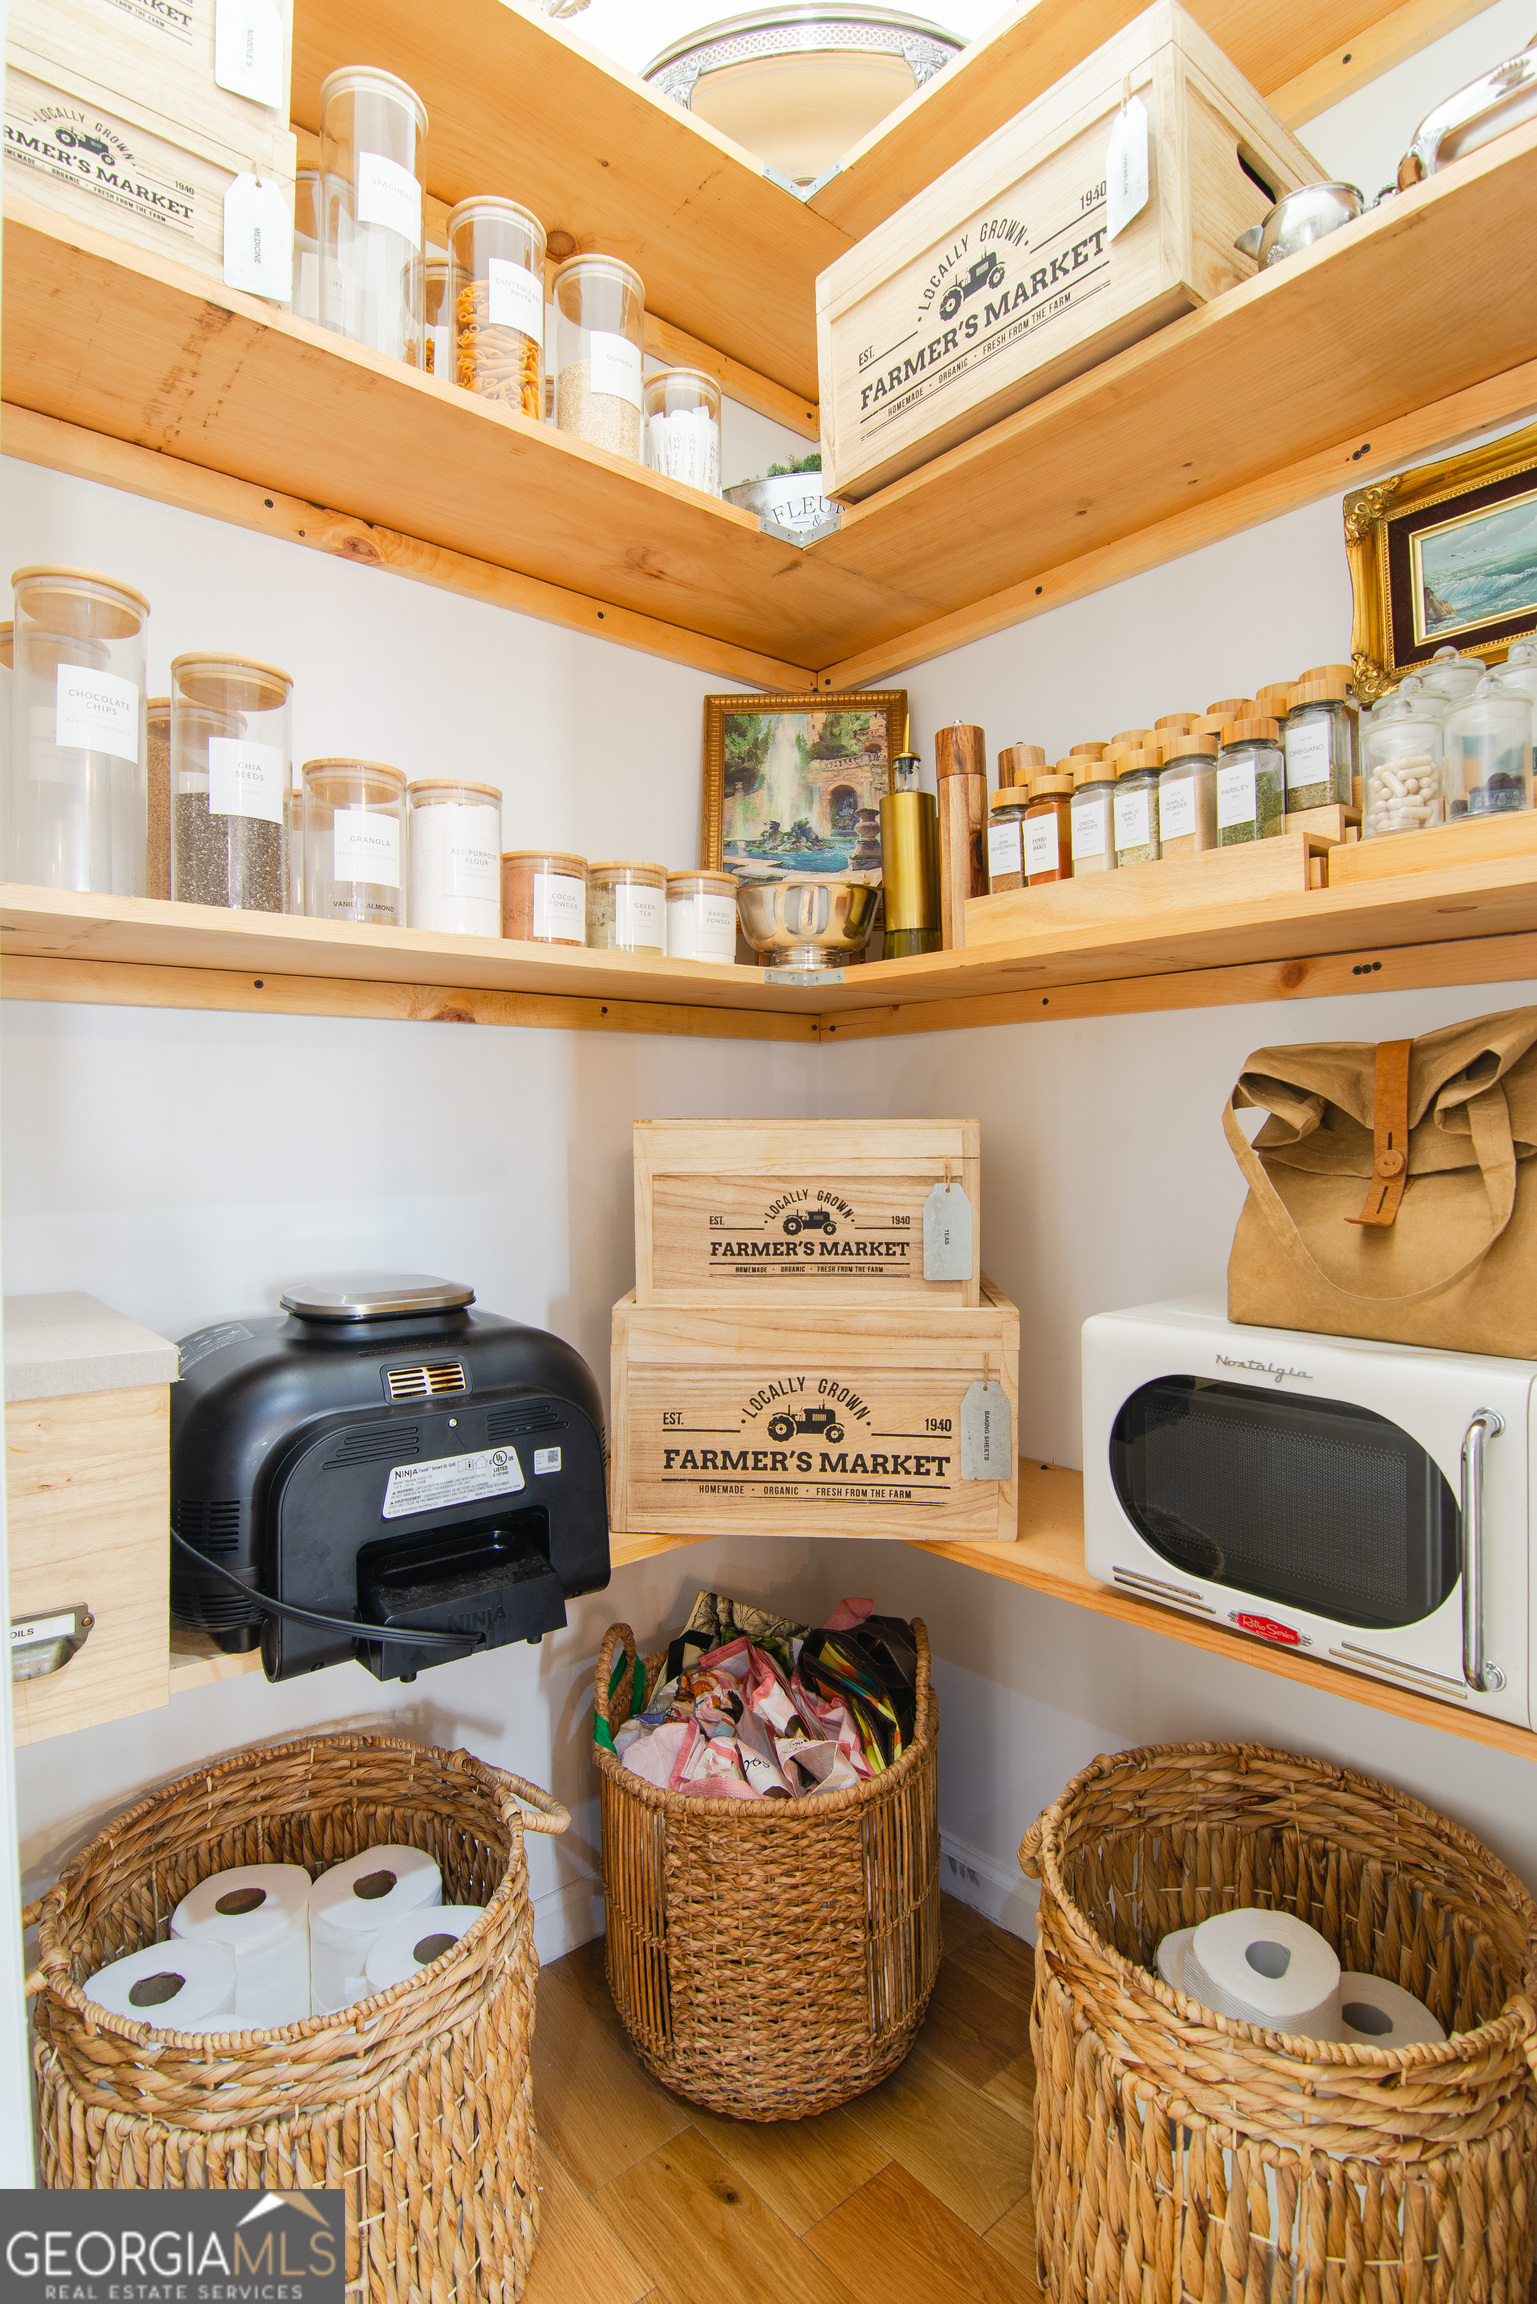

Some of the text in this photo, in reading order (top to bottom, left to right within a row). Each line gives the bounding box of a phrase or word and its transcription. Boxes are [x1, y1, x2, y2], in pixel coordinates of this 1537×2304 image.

[34, 107, 135, 160] LOCALLY GROWN
[96, 166, 194, 219] MARKET
[175, 180, 194, 195] 1940
[1080, 180, 1107, 210] 1940
[254, 226, 262, 265] MEDICINE
[918, 218, 1028, 311] LOCALLY GROWN
[860, 225, 1108, 411] FARMER'S MARKET
[859, 345, 875, 367] EST.
[887, 291, 1071, 417] HOMEMADE ORGANIC FRESH FROM THE FARM
[606, 354, 633, 369] QUINOA
[68, 689, 131, 712] CHOCOLATE
[85, 701, 117, 716] CHIPS
[1288, 743, 1325, 758] OREGANO
[238, 761, 262, 772] CHIA
[235, 770, 264, 782] SEEDS
[1221, 783, 1250, 796] PARSLEY
[1165, 802, 1188, 812] POWDER
[1166, 797, 1186, 807] GARLIC
[350, 835, 391, 847] GRANOLA
[451, 848, 498, 862] ALL-PURPOSE
[465, 857, 489, 866] FLOUR
[551, 893, 576, 902] COCOA
[366, 902, 395, 913] ALMOND
[549, 900, 578, 910] POWDER
[634, 903, 656, 911] GREEN
[706, 917, 731, 926] POWDER
[707, 911, 730, 919] BAKING
[767, 1188, 855, 1220] LOCALLY GROWN
[709, 1216, 725, 1226] EST.
[891, 1215, 911, 1225] 1940
[710, 1240, 910, 1257] FARMER'S MARKET
[735, 1266, 768, 1274] HOMEMADE
[1215, 1354, 1314, 1384] Nostalgia
[742, 1376, 871, 1421] LOCALLY GROWN
[663, 1412, 685, 1426] EST.
[924, 1418, 952, 1432] 1940
[495, 1453, 504, 1463] UL
[663, 1449, 951, 1477] FARMER'S MARKET
[394, 1468, 418, 1480] NINJA
[493, 1465, 508, 1473] LISTED
[699, 1485, 912, 1499] HOMEMADE ORGANIC FRESH FROM THE FARM
[10, 1627, 35, 1640] OILS
[1241, 1614, 1266, 1631] Retro
[1266, 1623, 1296, 1640] Series
